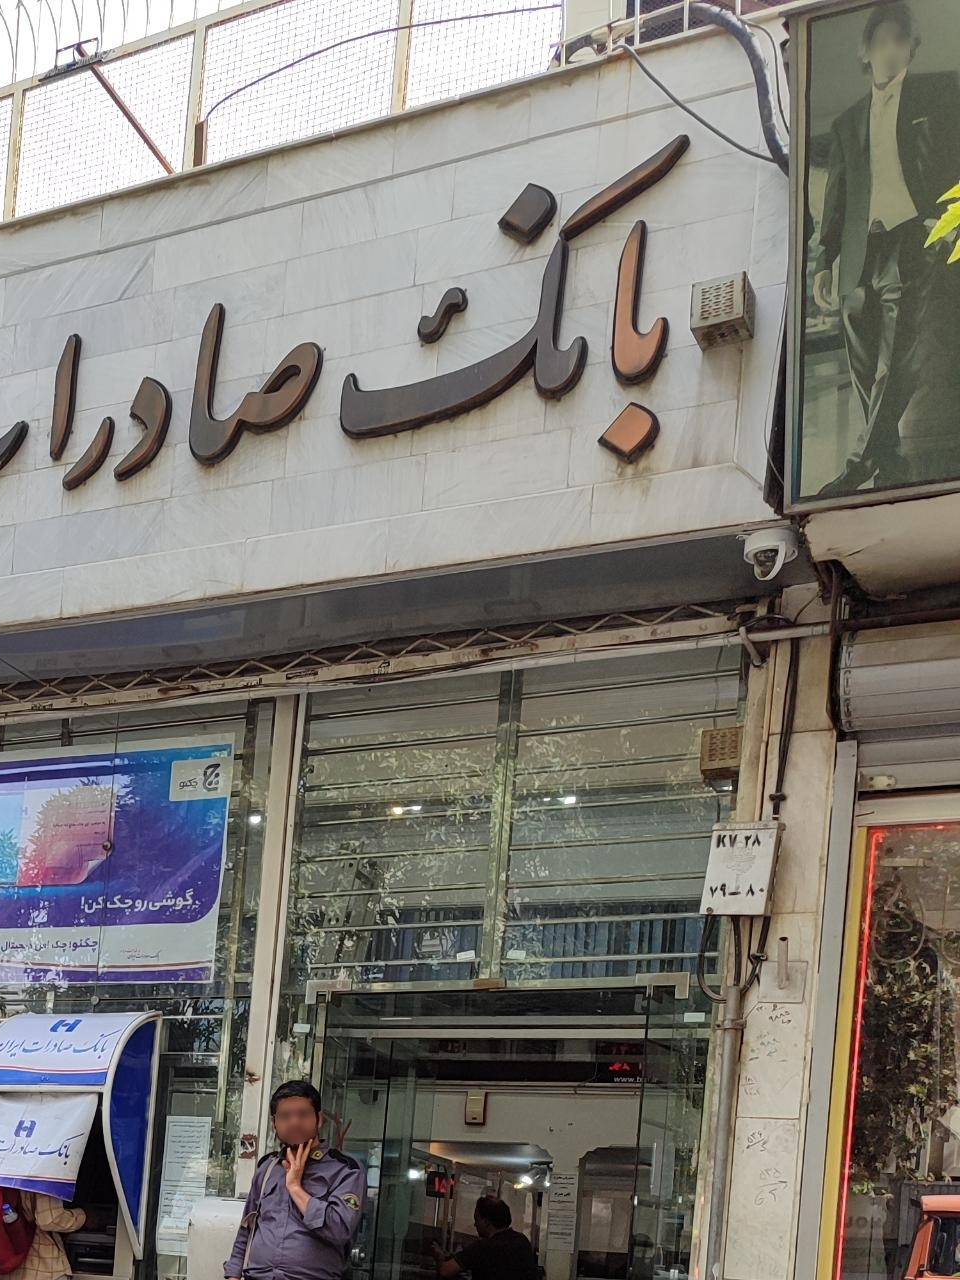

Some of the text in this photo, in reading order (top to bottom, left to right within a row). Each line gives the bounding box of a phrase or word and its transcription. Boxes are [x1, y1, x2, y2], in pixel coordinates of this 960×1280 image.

[339, 134, 691, 462] بانک
[106, 895, 133, 914] چک
[21, 1039, 73, 1053] صادرات
[72, 1028, 122, 1059] بانک
[38, 1132, 85, 1165] بانک
